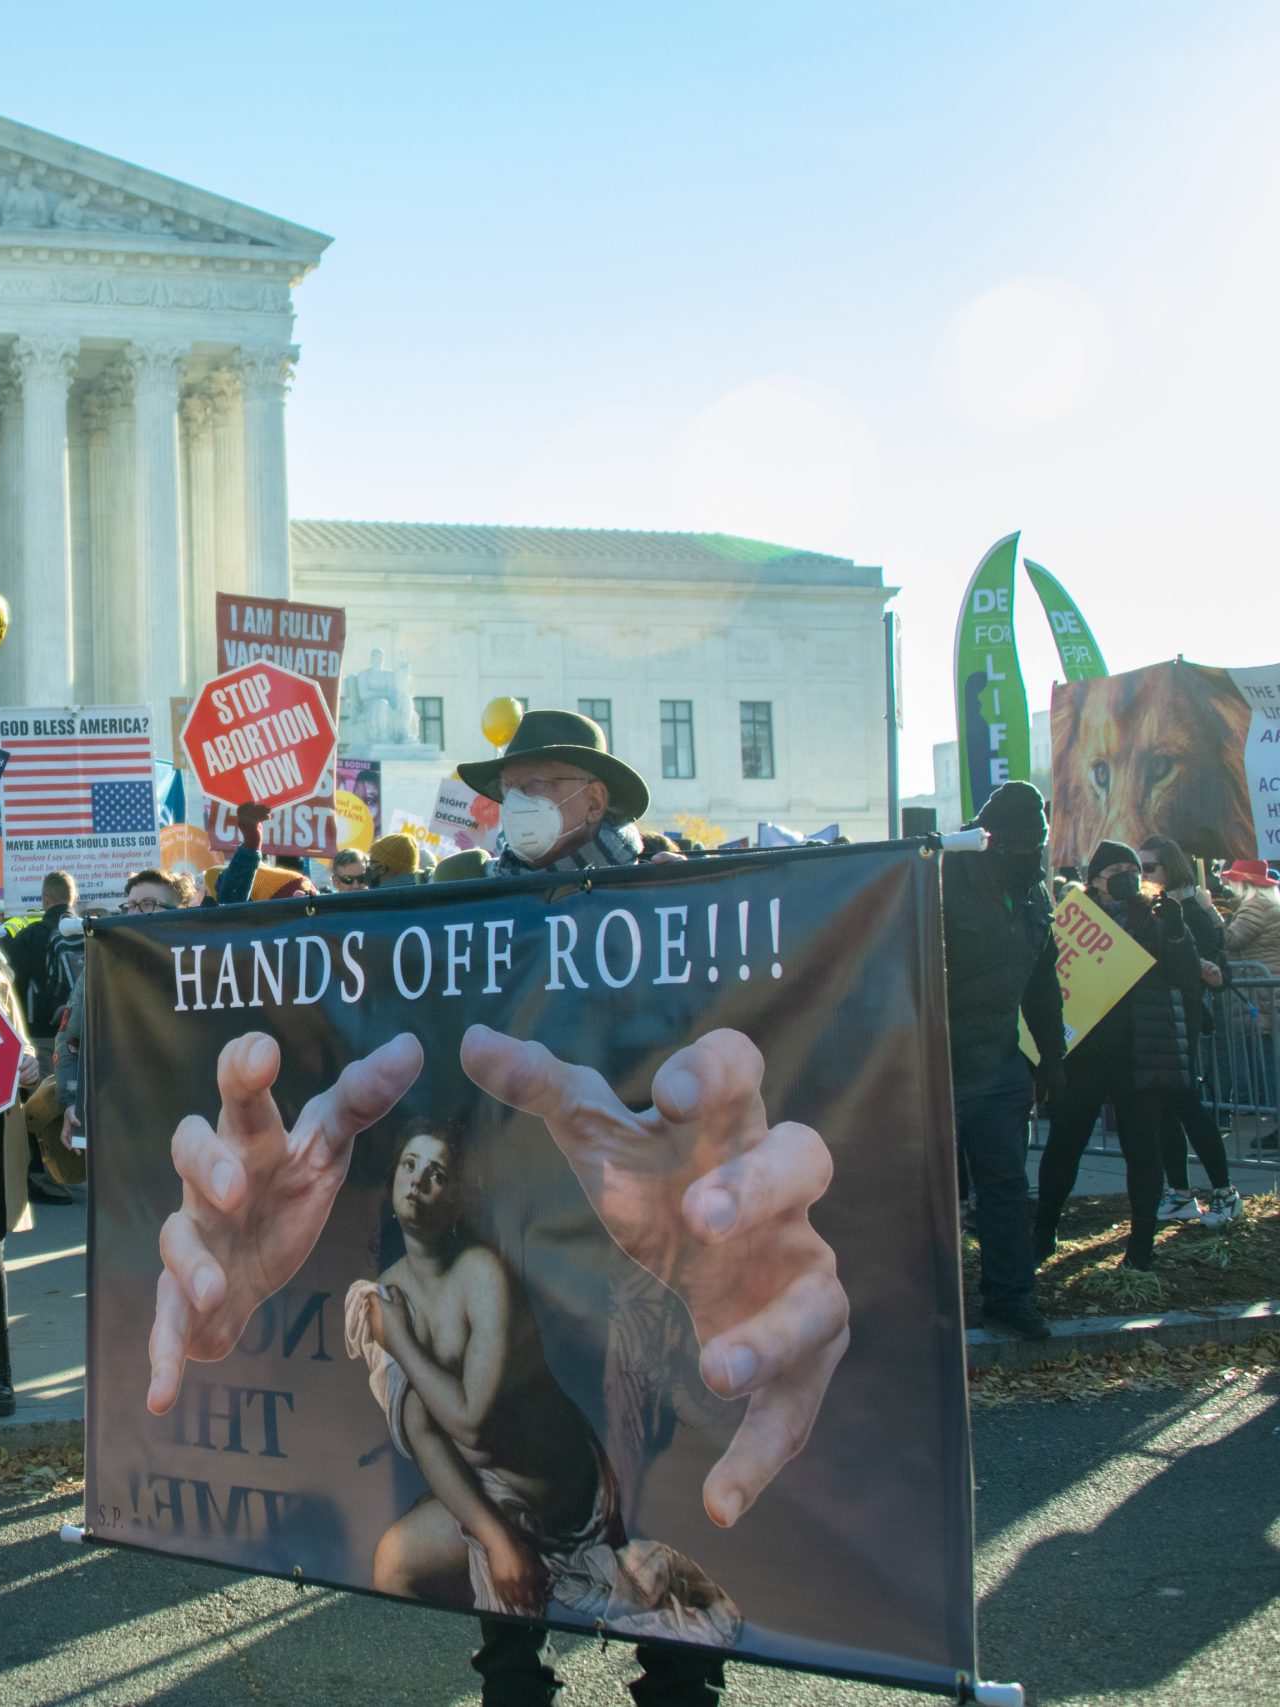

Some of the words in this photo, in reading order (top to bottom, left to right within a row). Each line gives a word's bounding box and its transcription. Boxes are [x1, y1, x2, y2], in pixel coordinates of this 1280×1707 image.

[230, 604, 238, 632] I
[243, 606, 273, 636] AM
[279, 610, 332, 642] FULLY
[223, 639, 340, 678] VACCINATED
[211, 673, 271, 725] STOP
[986, 653, 1009, 786] LIFE
[0, 720, 29, 736] GOD
[33, 719, 75, 735] BLESS
[79, 717, 149, 734] AMERICA?
[202, 702, 320, 777] ABORTION
[243, 750, 303, 801] NOW
[434, 811, 480, 829] DECISION
[439, 796, 469, 810] RIGHT
[6, 840, 34, 851] MAYBE
[36, 839, 73, 850] AMERICA
[76, 837, 109, 849] SHOULD
[111, 836, 137, 848] BLESS
[138, 836, 157, 846] GOD
[215, 804, 334, 849] CRIST
[1056, 902, 1114, 965] STOP.
[171, 929, 367, 1012] HANDS
[393, 919, 516, 1000] OFF
[545, 898, 784, 991] ROE!!!
[97, 1505, 125, 1529] S.P.
